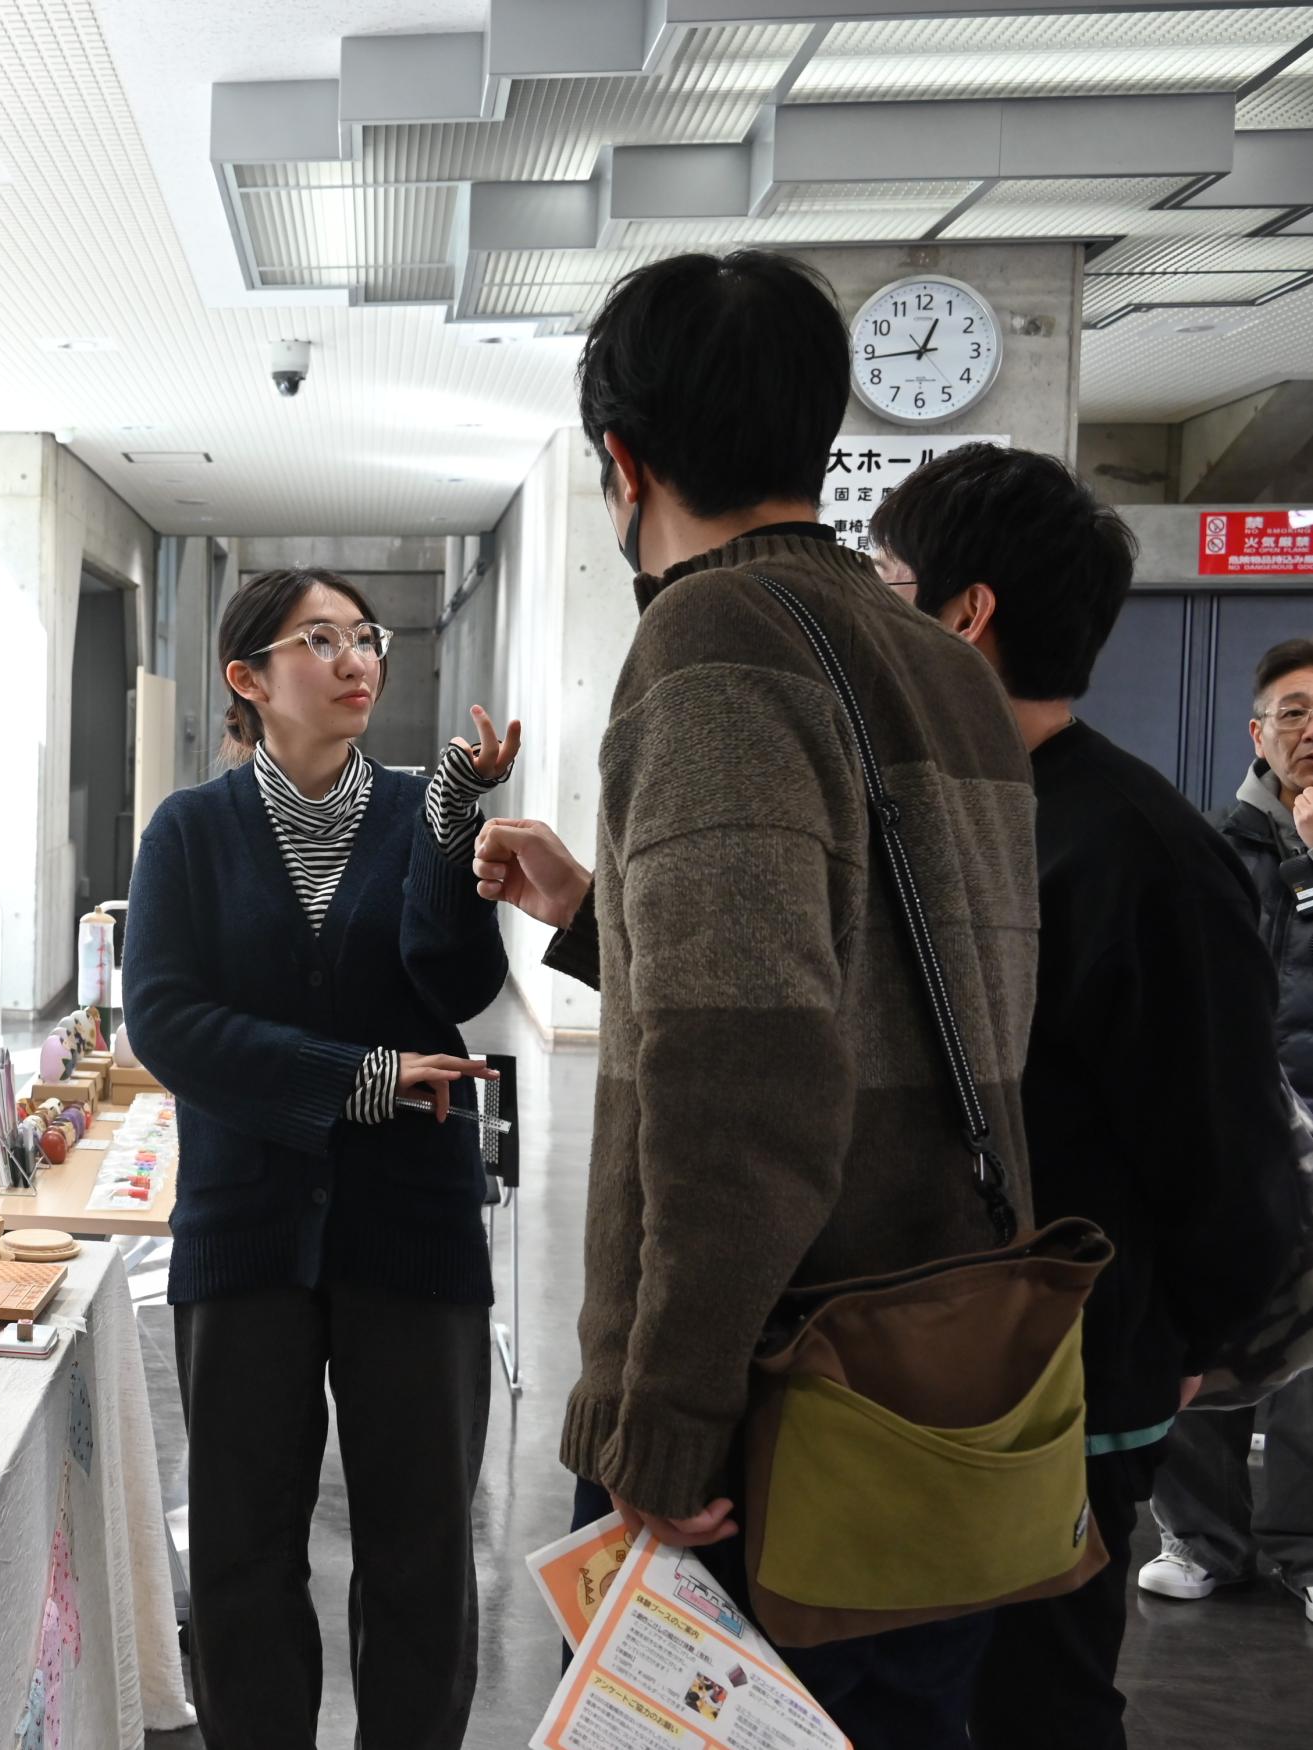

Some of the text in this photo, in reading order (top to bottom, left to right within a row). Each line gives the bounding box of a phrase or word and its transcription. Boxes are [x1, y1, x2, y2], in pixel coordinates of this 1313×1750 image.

[892, 301, 907, 317] 11
[915, 294, 934, 310] 12
[946, 300, 953, 316] 1
[872, 320, 891, 336] 10
[963, 317, 974, 334] 2
[864, 344, 875, 360] 9
[970, 342, 981, 359] 3
[870, 368, 882, 385] 8
[959, 368, 972, 384] 4
[890, 386, 901, 402] 7
[914, 392, 925, 409] 6
[941, 386, 952, 403] 5
[592, 1676, 681, 1735] アンケートご協力のお願い
